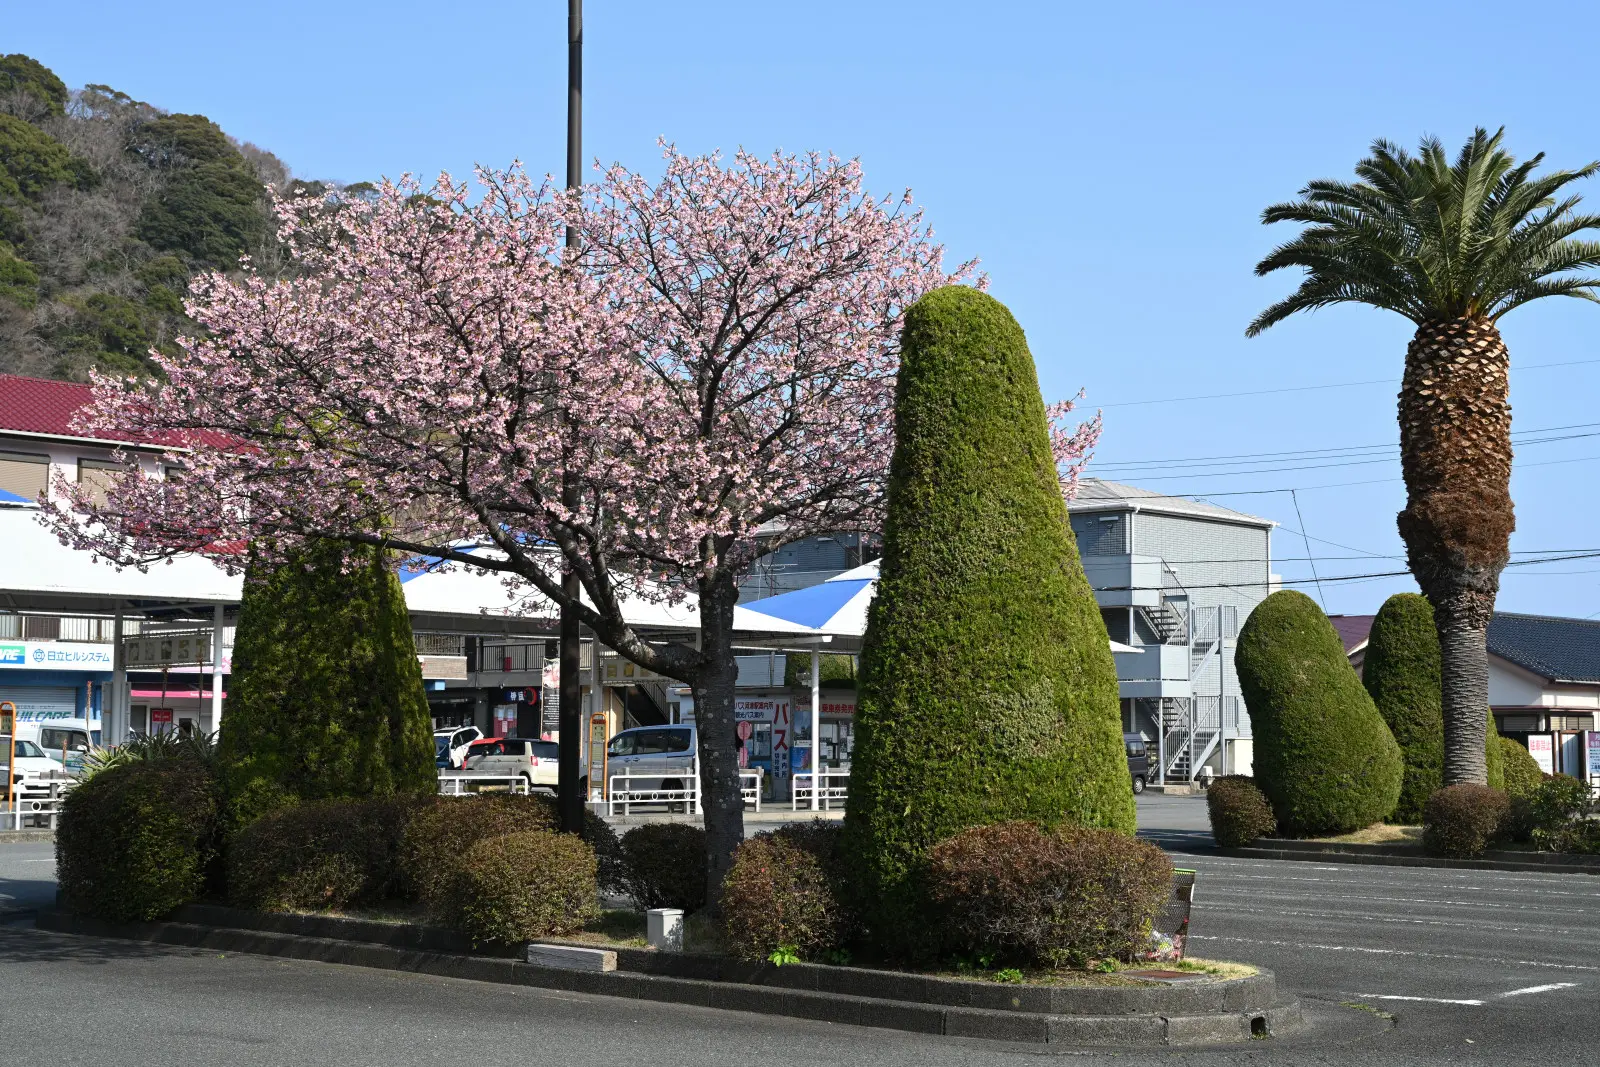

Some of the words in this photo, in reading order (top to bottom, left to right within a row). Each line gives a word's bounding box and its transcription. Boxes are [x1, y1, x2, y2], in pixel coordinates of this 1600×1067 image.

[821, 703, 857, 714] 乗車券発売
[15, 711, 71, 722] UILCARE
[773, 702, 789, 750] バス
